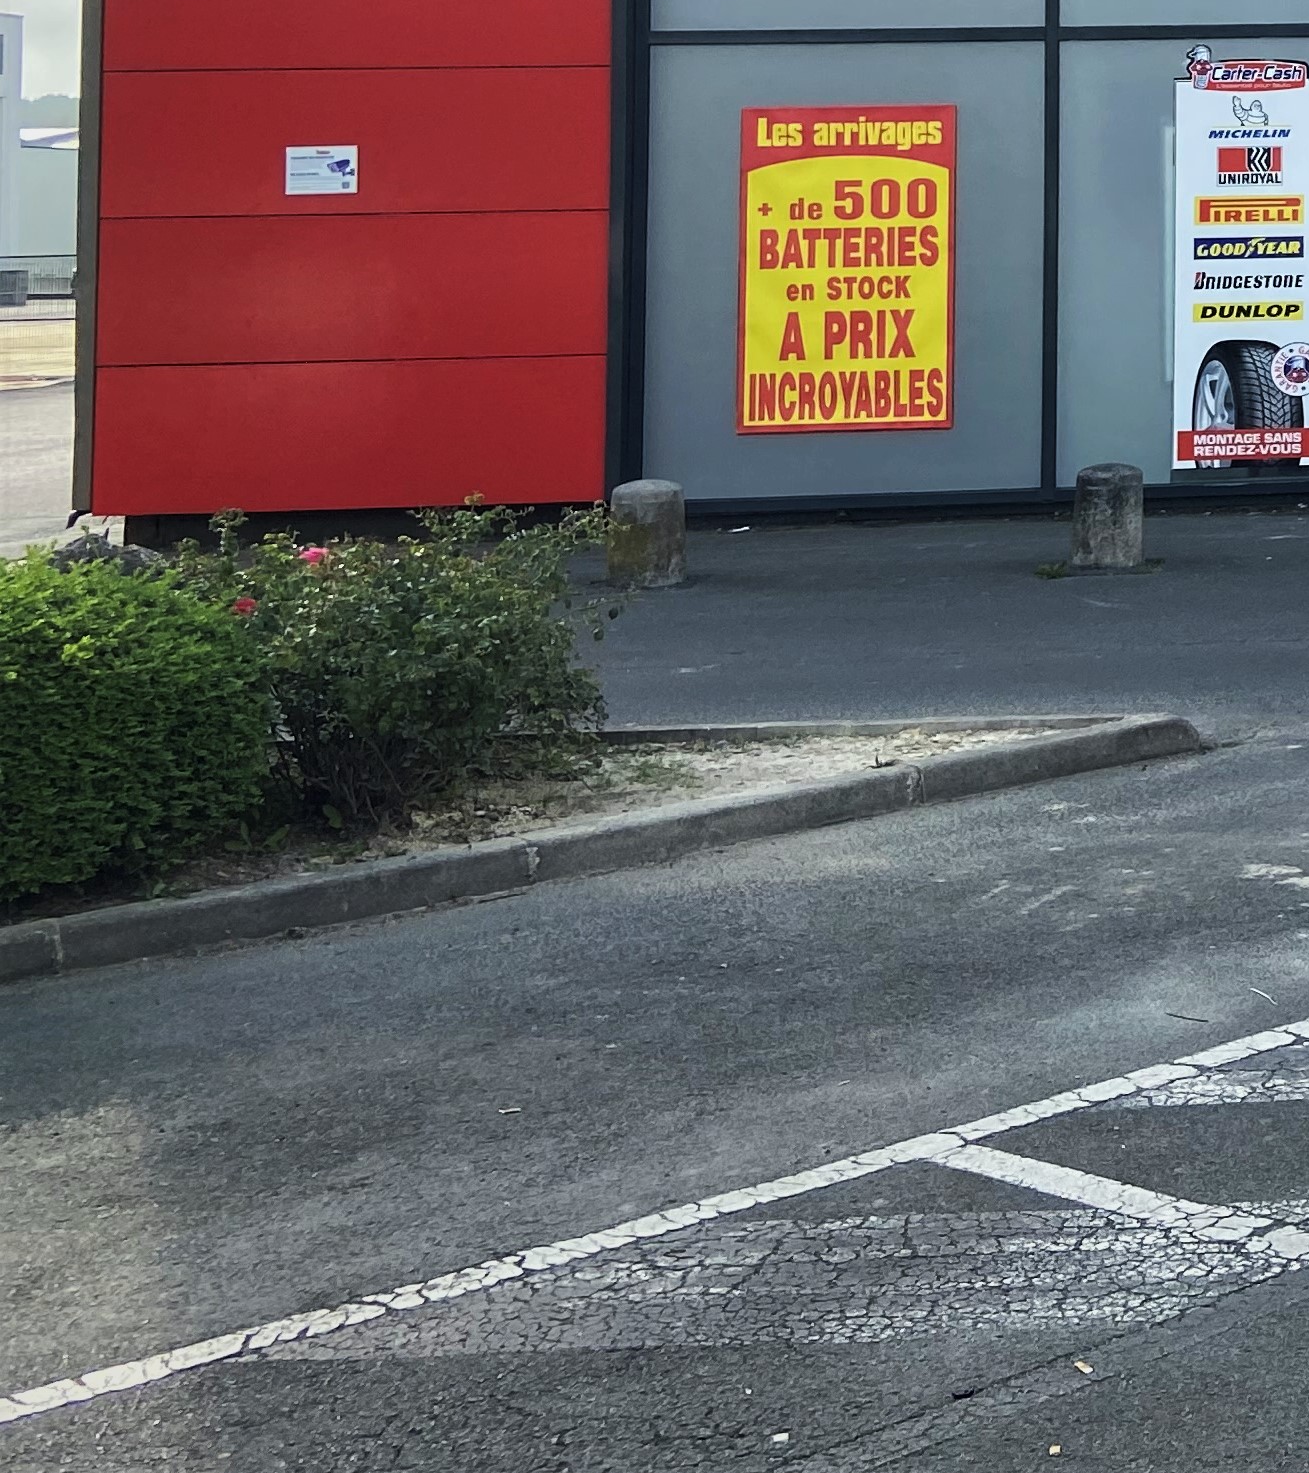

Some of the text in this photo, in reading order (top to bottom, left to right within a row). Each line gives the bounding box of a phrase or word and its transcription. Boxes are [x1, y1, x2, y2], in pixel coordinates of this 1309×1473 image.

[1211, 65, 1303, 81] Carter-Cash
[757, 116, 943, 151] Les arrivages
[1208, 129, 1291, 139] MICHELIN
[1218, 172, 1282, 185] UNIROYAL
[789, 198, 823, 220] de
[833, 178, 938, 220] 500
[1199, 197, 1301, 223] PIRELLI
[759, 224, 940, 270] BATTERIES
[786, 275, 912, 302] en STOCK
[1200, 304, 1300, 319] DUNLOP
[779, 308, 917, 361] A PRIX
[748, 367, 945, 422] INCROYABLES
[1193, 431, 1302, 446] MONTAGE SANS
[1193, 443, 1302, 457] RENDEZ-VOUS
